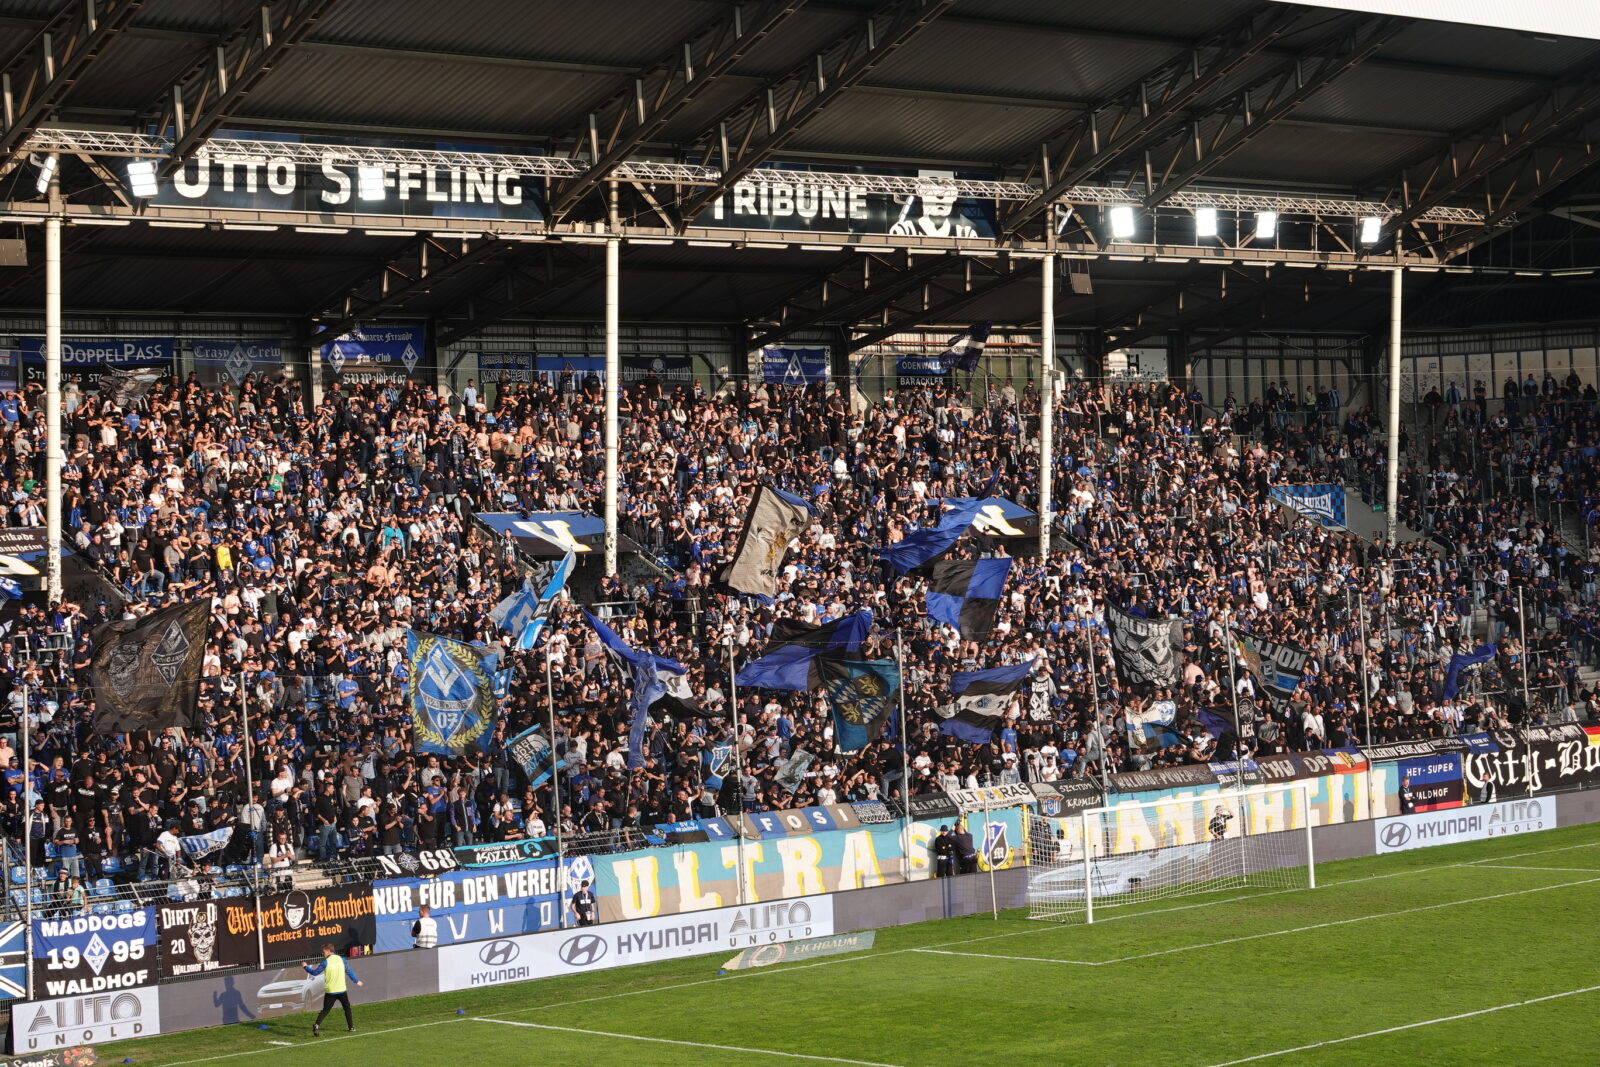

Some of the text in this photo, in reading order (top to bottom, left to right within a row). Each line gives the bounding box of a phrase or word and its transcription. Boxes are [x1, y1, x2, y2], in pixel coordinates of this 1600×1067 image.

[321, 153, 523, 205] SFFLING
[62, 343, 162, 363] DOPPELPASS
[194, 345, 280, 358] Crazy Crew
[216, 372, 229, 383] 19
[1406, 767, 1422, 777] HEY
[1427, 762, 1454, 775] SUPER
[1488, 800, 1543, 825] AUTO
[1416, 815, 1482, 840] HYUNDAI
[1488, 821, 1543, 836] UNOLD
[418, 849, 457, 868] 68
[475, 848, 528, 865] ASOZIAL
[611, 822, 938, 920] ULTRAS
[374, 885, 413, 916] NUR
[419, 878, 456, 910] FÜR
[462, 874, 499, 907] DEN
[41, 910, 147, 937] MADDOGS
[160, 906, 198, 930] DIRTY
[729, 900, 812, 934] AUTO
[266, 924, 342, 944] brothers in blood
[617, 921, 719, 955] HYUNDAI
[729, 926, 813, 948] UNOLD
[792, 936, 858, 955] EICHBAUM
[46, 938, 145, 970] 19 95
[171, 938, 186, 955] 20
[46, 969, 149, 996] WALDHOF
[471, 965, 530, 986] HYUNDAI
[28, 992, 142, 1033] AUTO
[28, 1022, 143, 1049] UNOLD
